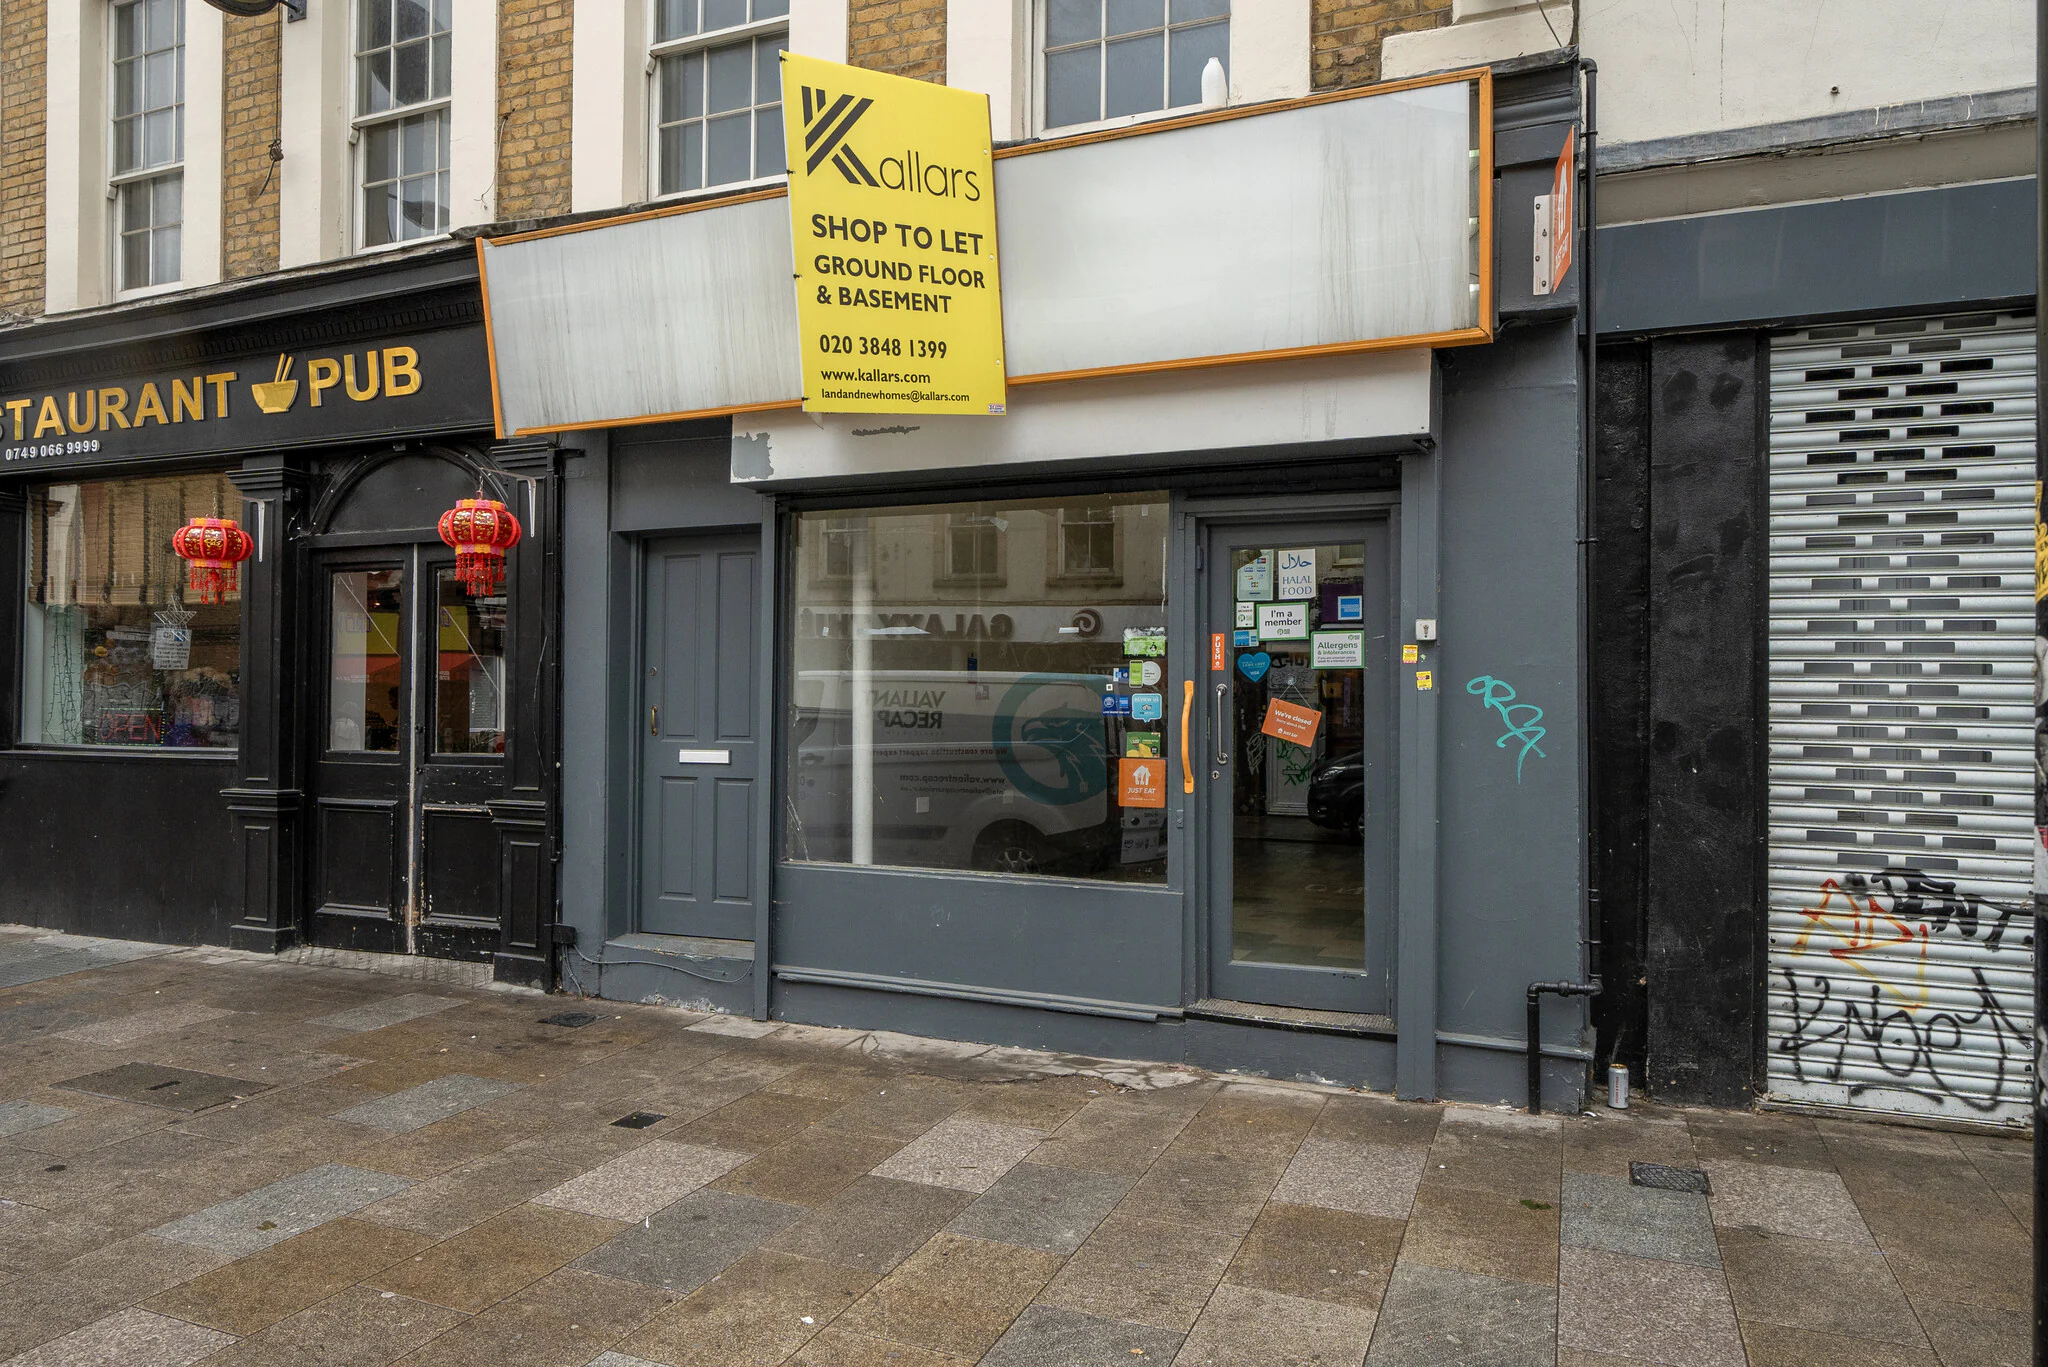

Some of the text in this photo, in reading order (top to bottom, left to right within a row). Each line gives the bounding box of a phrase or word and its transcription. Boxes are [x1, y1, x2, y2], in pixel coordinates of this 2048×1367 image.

[801, 85, 981, 202] Kallars
[811, 213, 984, 255] SHOP TO LET
[814, 254, 986, 288] GROUND FLOOR
[816, 285, 952, 313] & BASEMENT
[819, 334, 948, 359] 020 3848 1399
[308, 346, 422, 408] PUB
[821, 368, 931, 384] www.kallars.com
[821, 388, 970, 403] landandnewhomes@kallars.com
[5, 439, 101, 461] 0749 066 9999
[1281, 553, 1312, 570] حلال
[1282, 576, 1312, 585] HALAL
[1282, 586, 1312, 595] FOOD
[1264, 617, 1302, 627] member
[1271, 610, 1285, 618] I'm
[1317, 642, 1358, 650] Allergens
[97, 712, 163, 741] OPEN
